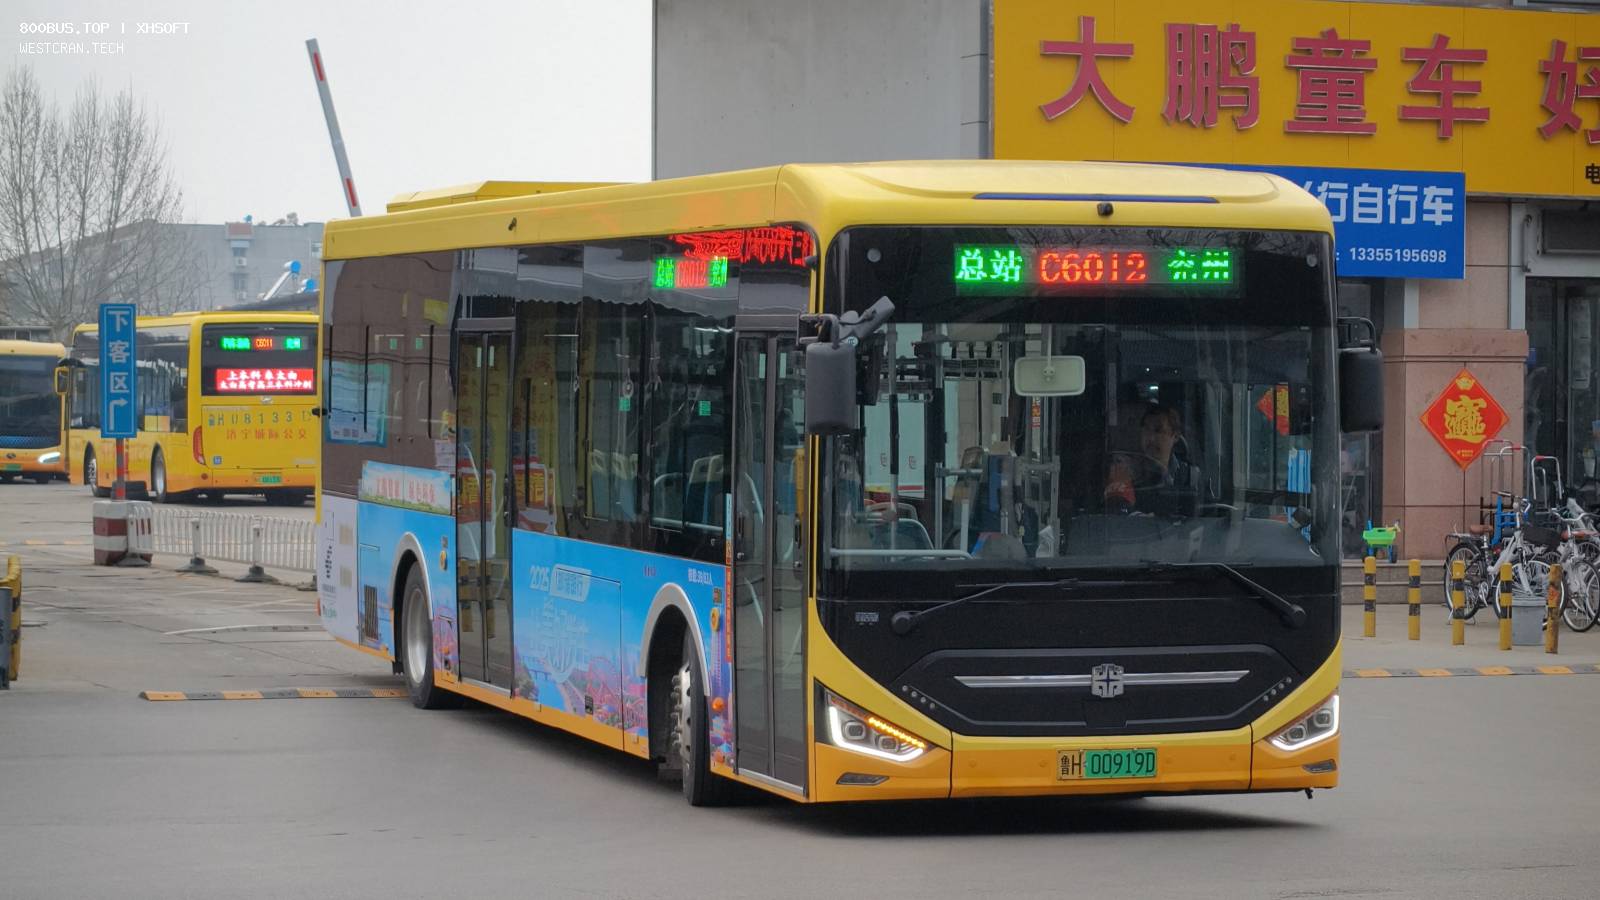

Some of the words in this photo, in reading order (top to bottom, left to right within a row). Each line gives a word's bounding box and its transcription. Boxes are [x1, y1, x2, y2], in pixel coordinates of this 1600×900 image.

[1039, 15, 1491, 140] 大鹏童车
[1303, 181, 1454, 226] 行自行车
[955, 248, 1023, 283] 总站
[1040, 252, 1146, 284] C6012
[1350, 248, 1447, 263] 13355195698
[107, 310, 131, 394] 下客区
[1091, 752, 1155, 775] 00919D
